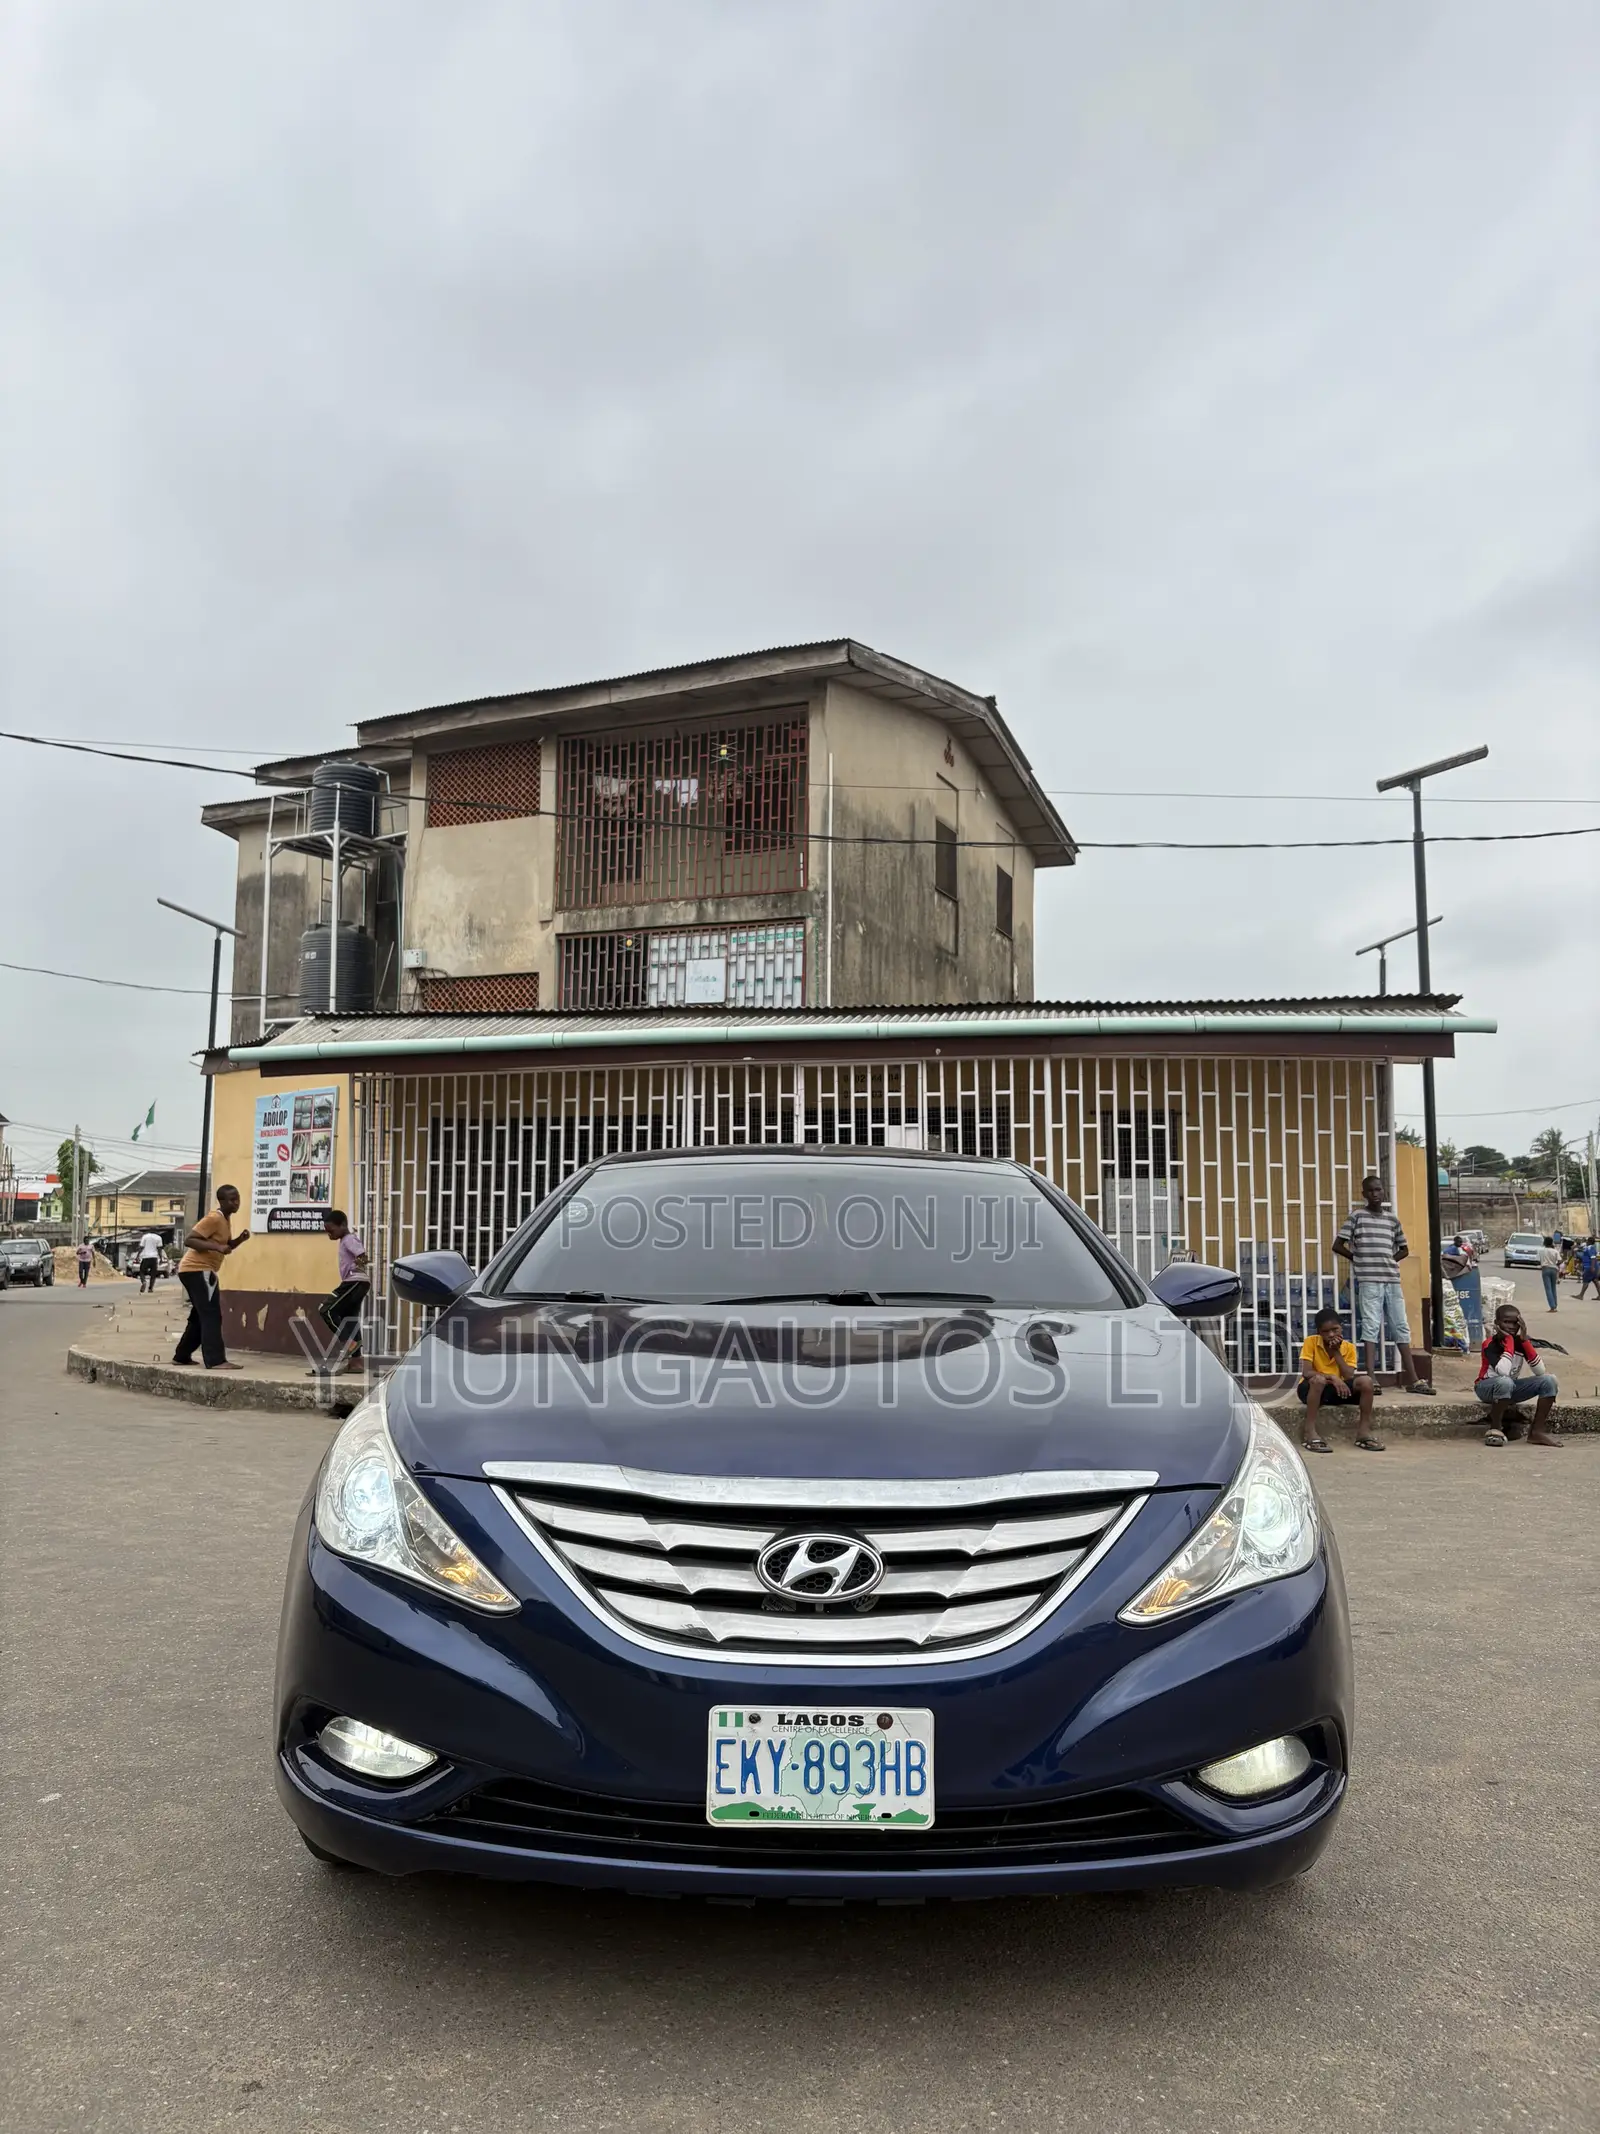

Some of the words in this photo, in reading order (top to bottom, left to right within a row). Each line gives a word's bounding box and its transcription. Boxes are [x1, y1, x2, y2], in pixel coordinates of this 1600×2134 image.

[263, 1110, 288, 1127] ADOLOP
[777, 1713, 865, 1727] LAGOS
[772, 1725, 803, 1733] CENTRE
[820, 1727, 870, 1735] EXCELLENCE
